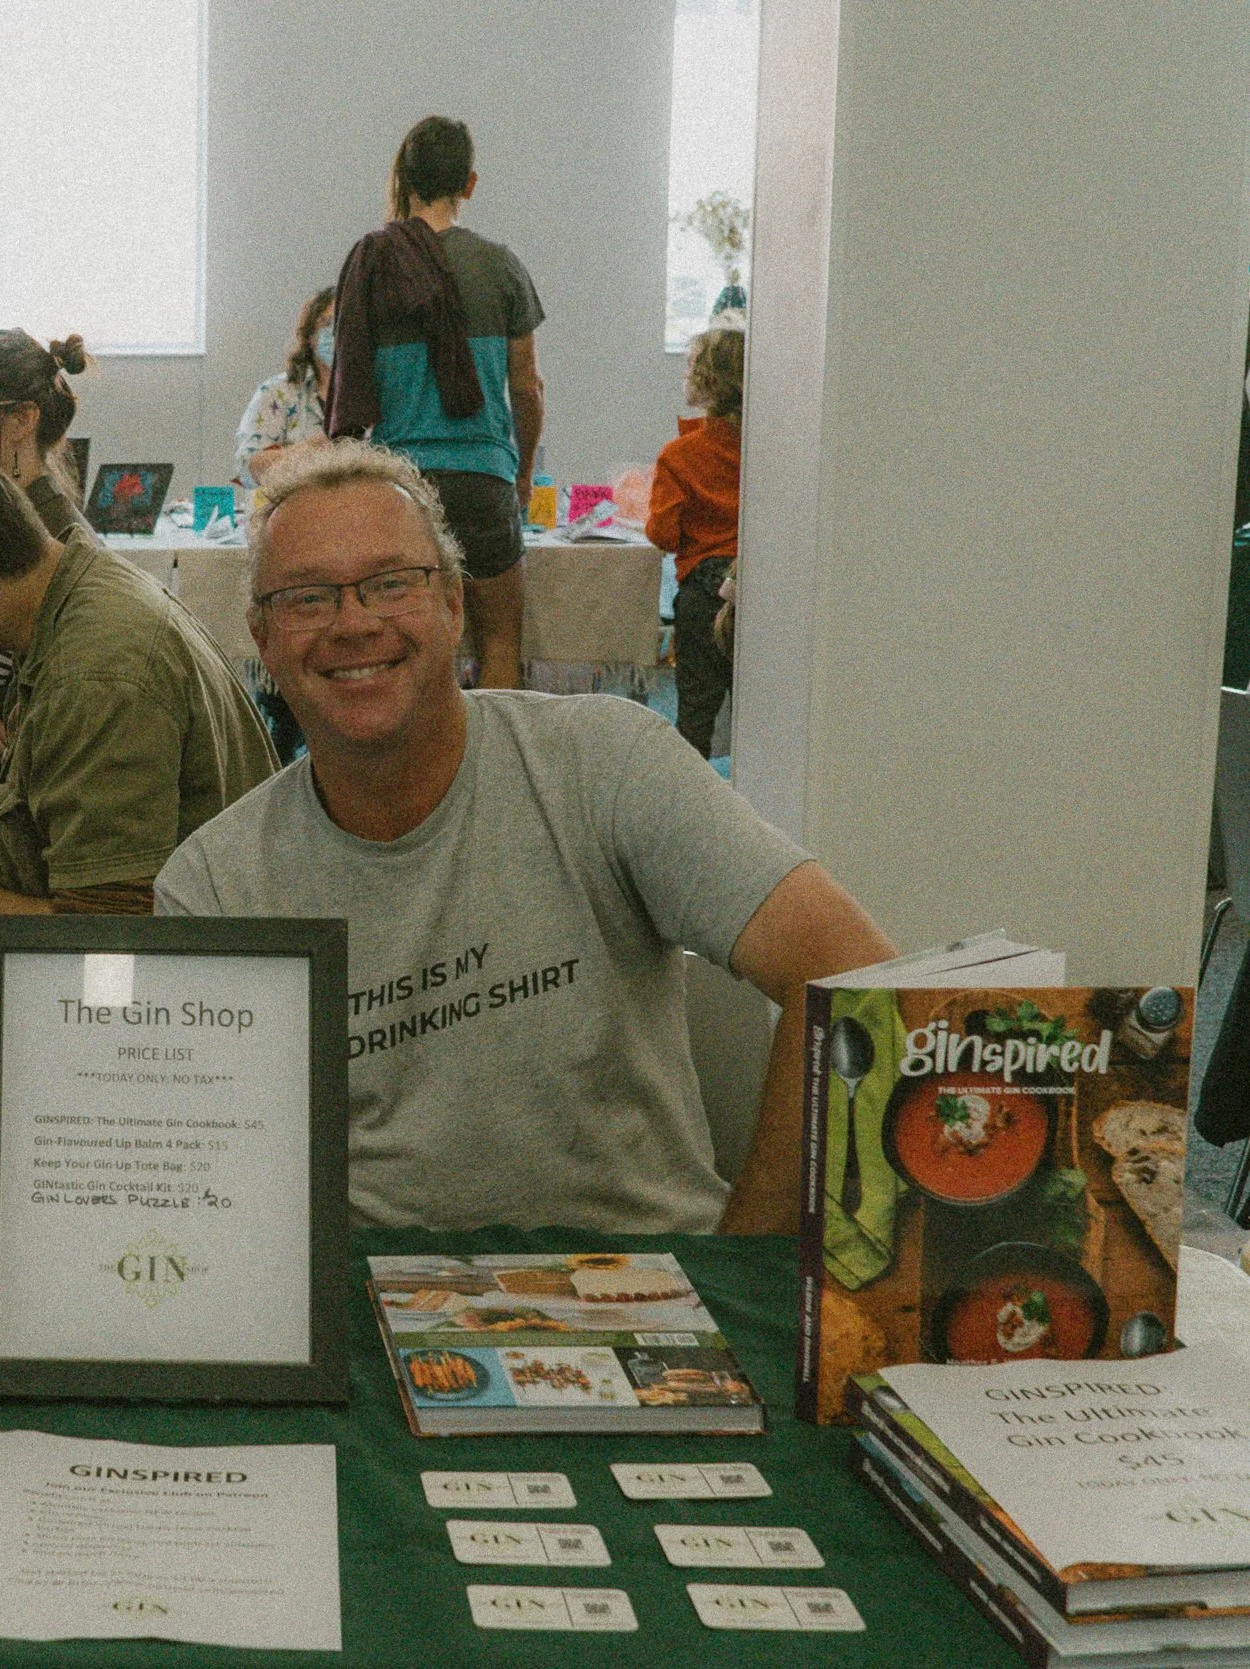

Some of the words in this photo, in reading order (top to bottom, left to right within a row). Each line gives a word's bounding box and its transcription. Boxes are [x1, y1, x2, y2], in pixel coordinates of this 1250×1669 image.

[349, 975, 414, 1015] THIS
[421, 962, 447, 990] IS
[455, 942, 489, 980] MY
[57, 999, 111, 1025] The
[122, 1001, 171, 1025] Gin
[180, 1001, 254, 1033] Shop
[348, 992, 481, 1060] DRINKING
[488, 959, 580, 1009] SHIRT
[118, 1047, 159, 1060] PRICE
[165, 1048, 194, 1061] LIST
[899, 1020, 1113, 1083] ginspired
[173, 1075, 190, 1084] NO
[97, 1116, 116, 1126] The
[119, 1117, 162, 1127] Ultimate
[166, 1118, 183, 1128] Gin
[116, 1138, 132, 1149] Lip
[135, 1139, 162, 1149] Balm
[166, 1140, 172, 1149] 4
[33, 1158, 61, 1169] Keep
[65, 1159, 90, 1169] Your
[94, 1160, 112, 1170] Gin
[115, 1160, 131, 1171] Up
[134, 1161, 159, 1171] Tote
[87, 1180, 105, 1191] Gin
[109, 1181, 153, 1192] Cocktail
[117, 1254, 186, 1282] GIN
[984, 1382, 1162, 1401] GINSPIRED
[990, 1410, 1055, 1426] The
[1064, 1404, 1210, 1423] Ultimate
[1006, 1433, 1066, 1448] Gin
[1074, 1427, 1244, 1445] Cookbook
[1118, 1452, 1185, 1471] $45
[69, 1463, 249, 1484] GINSPIRED
